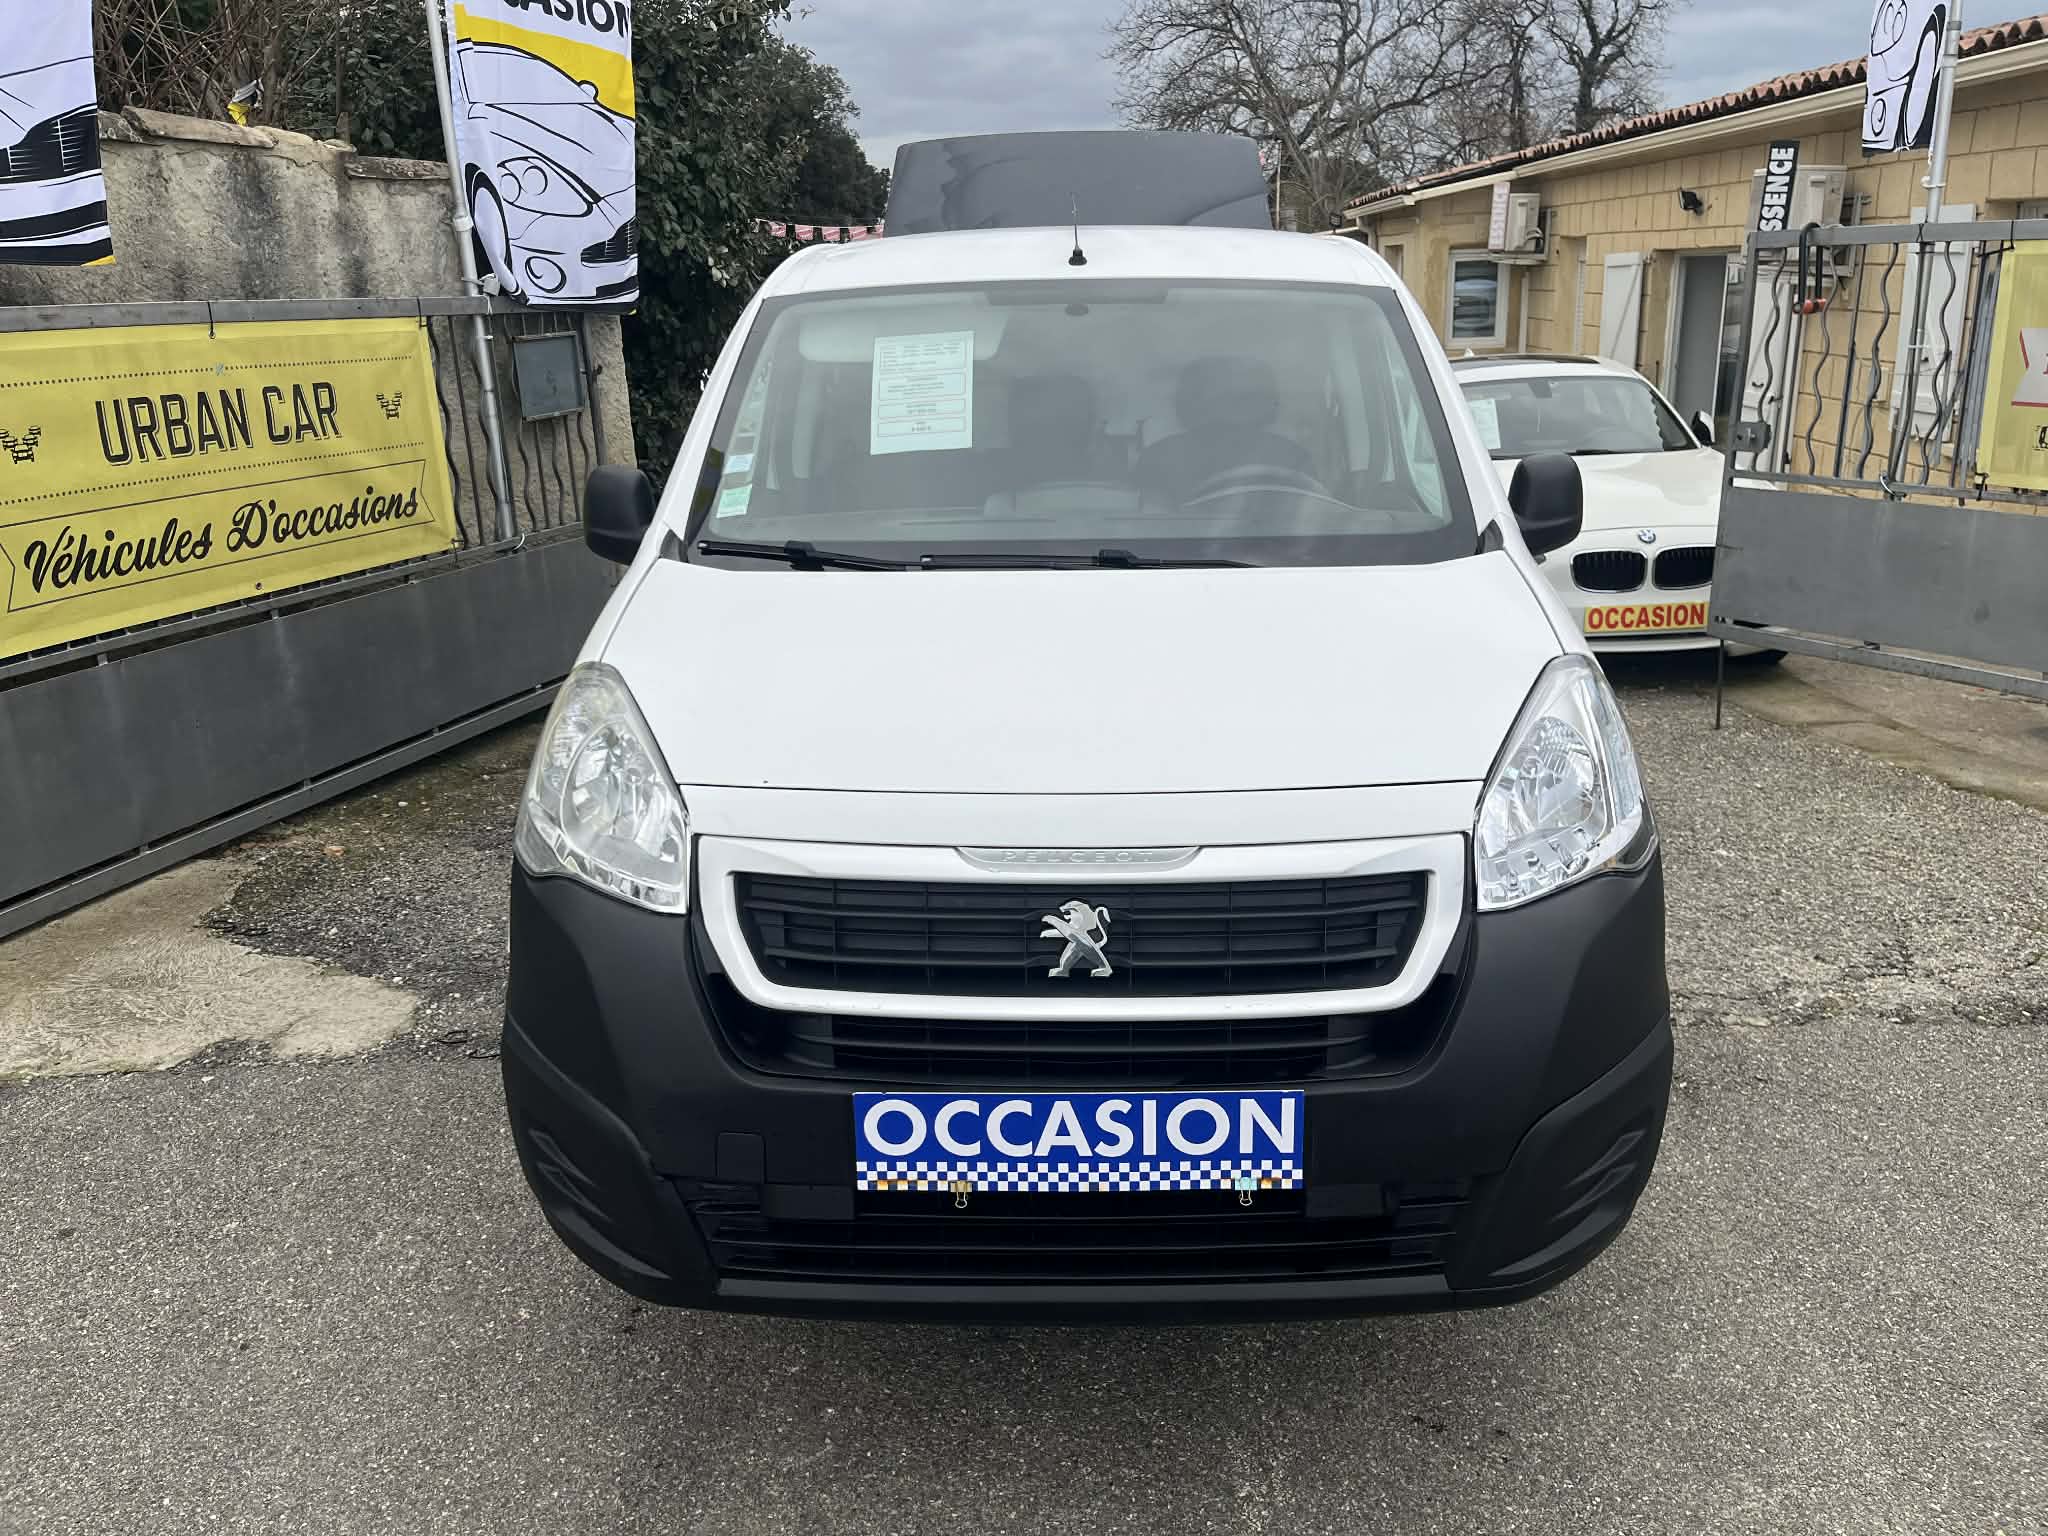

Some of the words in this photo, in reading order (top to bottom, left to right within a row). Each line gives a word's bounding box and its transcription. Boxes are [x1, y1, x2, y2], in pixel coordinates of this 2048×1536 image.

[1759, 147, 1795, 231] SSENCE
[95, 387, 254, 466] URBAN
[261, 381, 345, 445] CAR
[23, 516, 213, 594] Véhicules
[226, 485, 418, 552] D'occasions
[1588, 603, 1705, 630] OCCASION
[863, 1097, 1296, 1157] OCCASION
